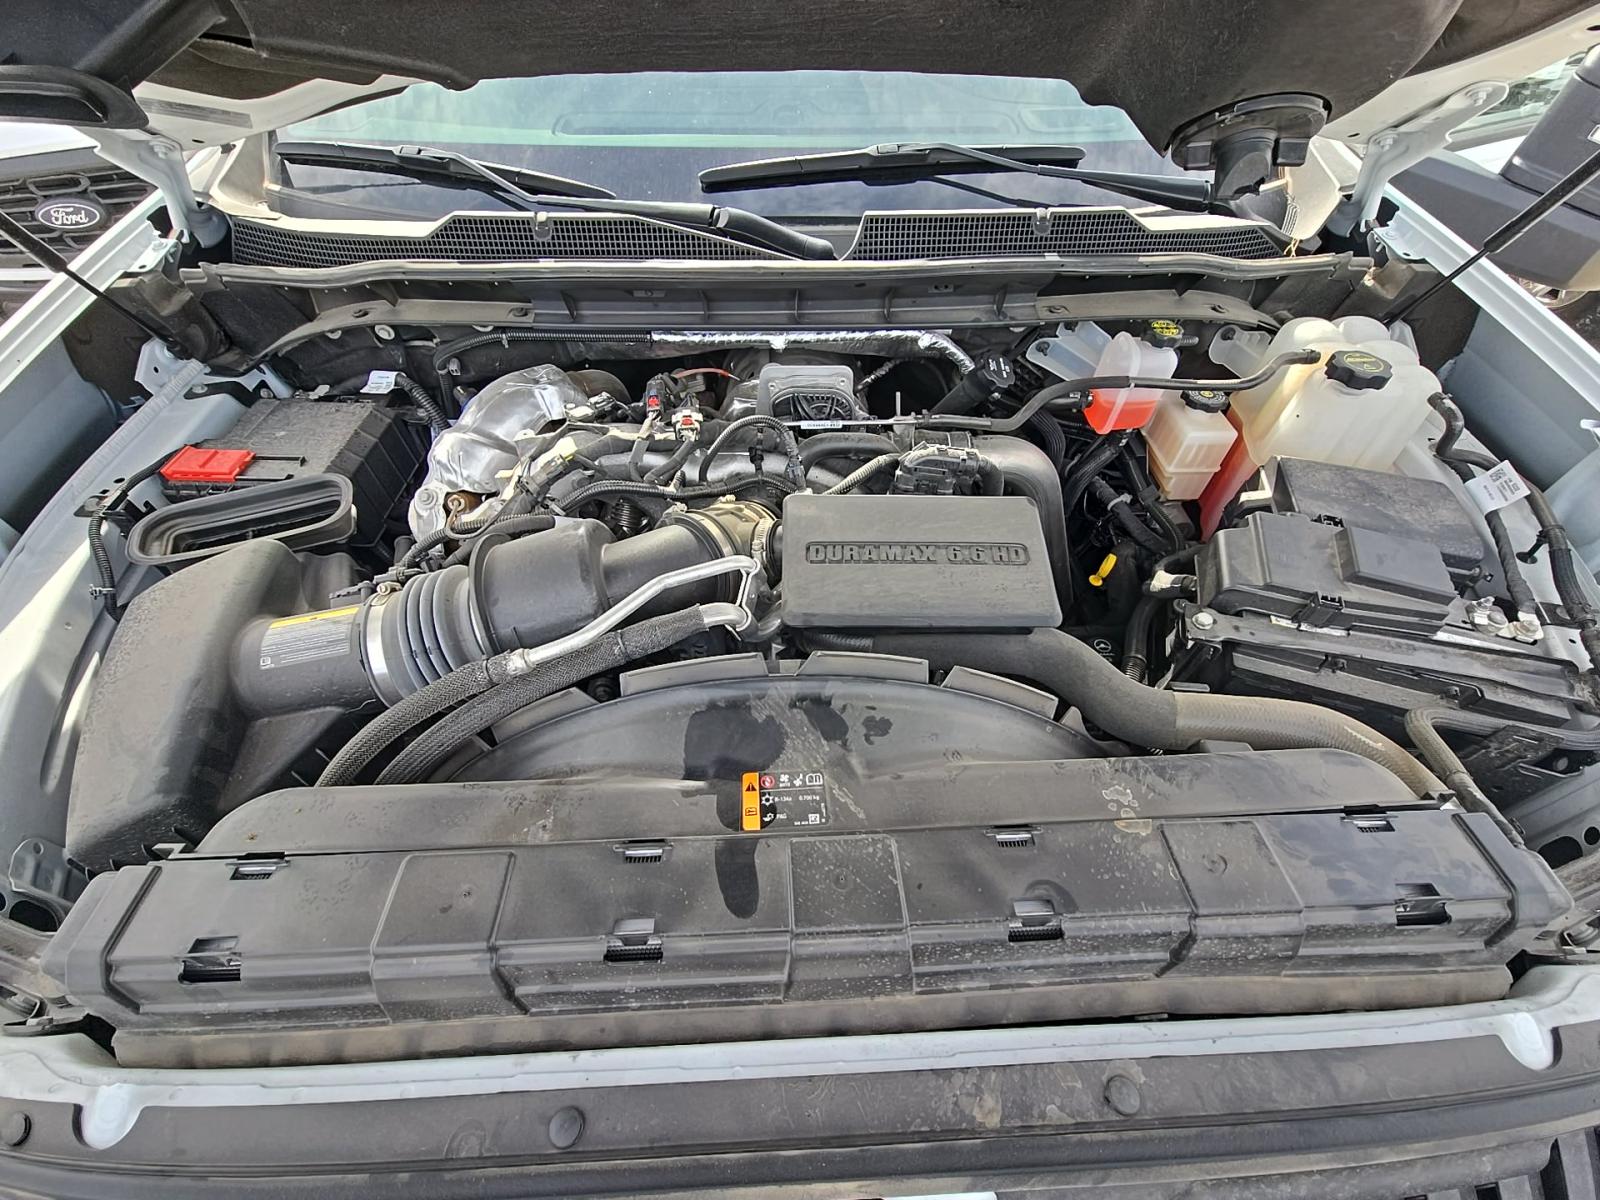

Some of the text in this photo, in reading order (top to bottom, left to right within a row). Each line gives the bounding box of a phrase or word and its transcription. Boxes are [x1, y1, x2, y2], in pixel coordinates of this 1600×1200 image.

[50, 207, 89, 225] Ford
[809, 544, 1027, 565] DURAMAX 6.6 HD
